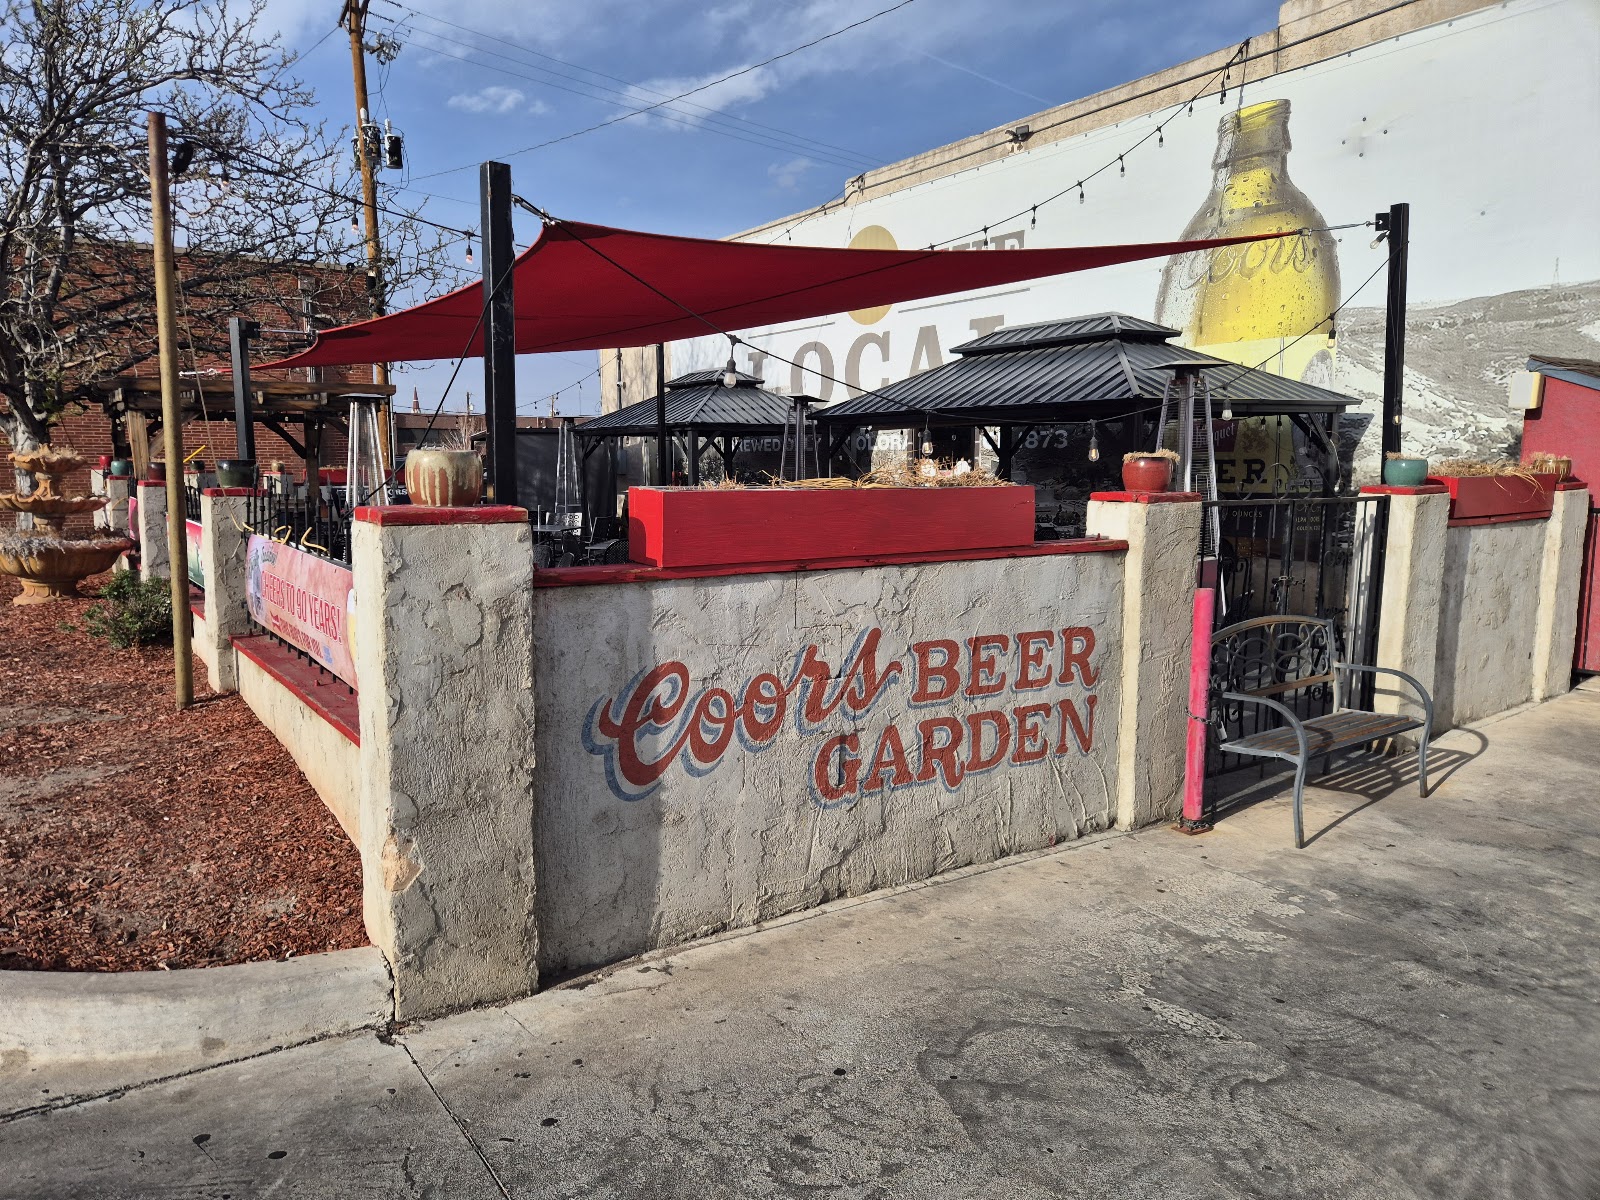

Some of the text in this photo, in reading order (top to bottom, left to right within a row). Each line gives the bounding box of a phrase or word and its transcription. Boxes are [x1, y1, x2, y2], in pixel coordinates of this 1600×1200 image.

[261, 570, 285, 610] CHEERS
[285, 582, 295, 616] TO
[296, 586, 307, 623] 90
[308, 593, 342, 645] YEARS!
[585, 626, 1099, 797] Coors BEER
[812, 695, 1098, 804] GARDEN
